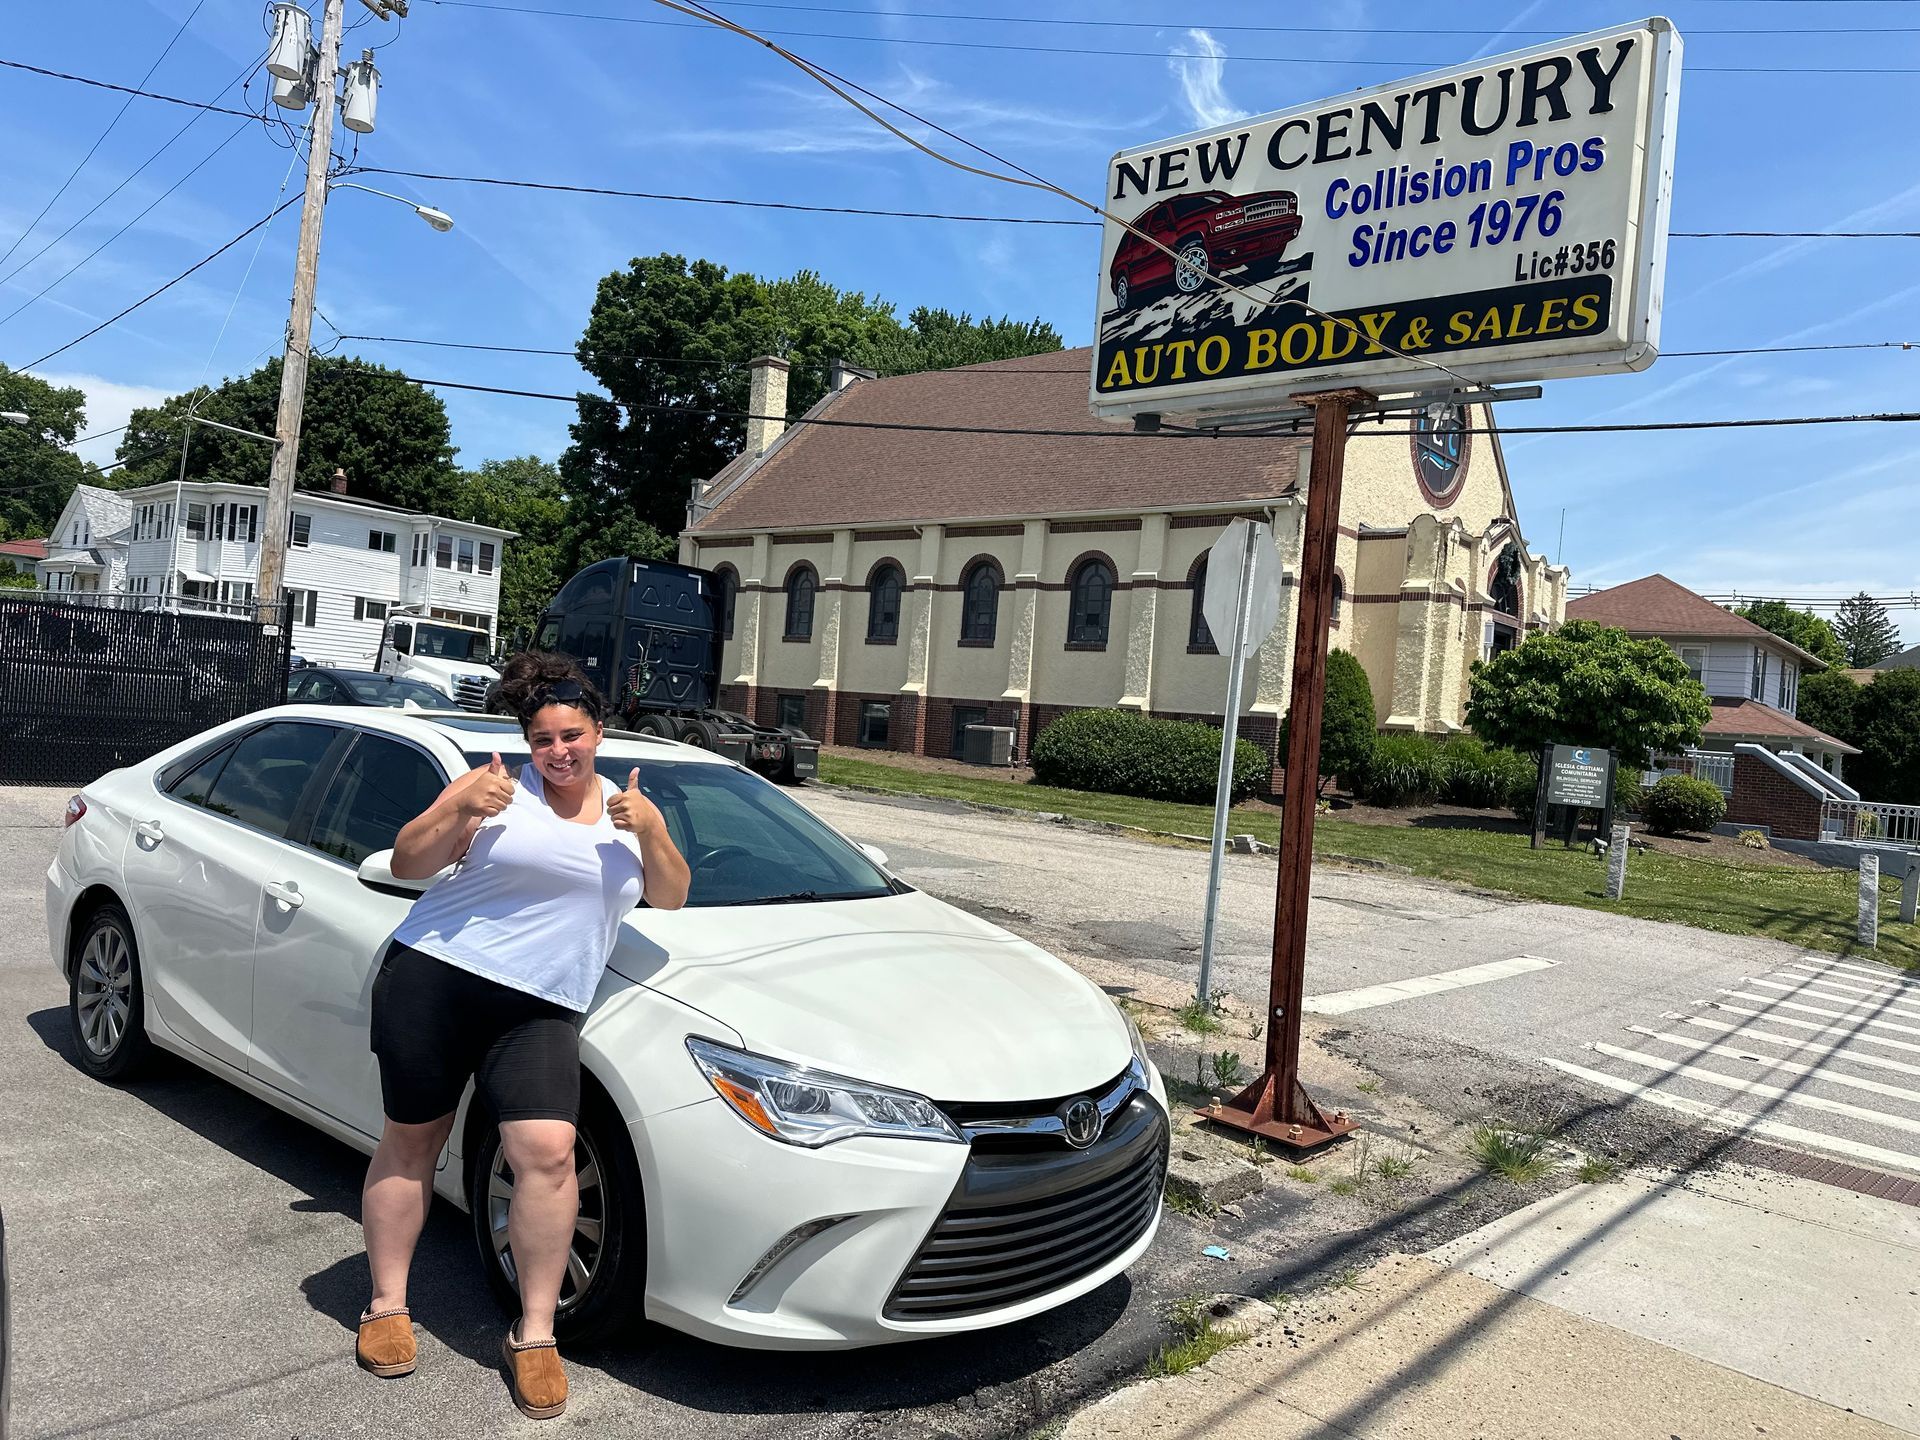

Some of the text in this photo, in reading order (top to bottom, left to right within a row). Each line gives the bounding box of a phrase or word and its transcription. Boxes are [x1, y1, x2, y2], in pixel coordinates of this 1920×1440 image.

[1113, 40, 1635, 200] NEW CENTURY
[1325, 137, 1604, 220] Collision Pros
[1347, 189, 1564, 269] Since 1976
[1515, 237, 1616, 282] Lic#356
[1102, 293, 1600, 388] AUTO BODY & SALES
[1561, 769, 1597, 777] COMUNITARIA
[1573, 750, 1590, 760] ICC
